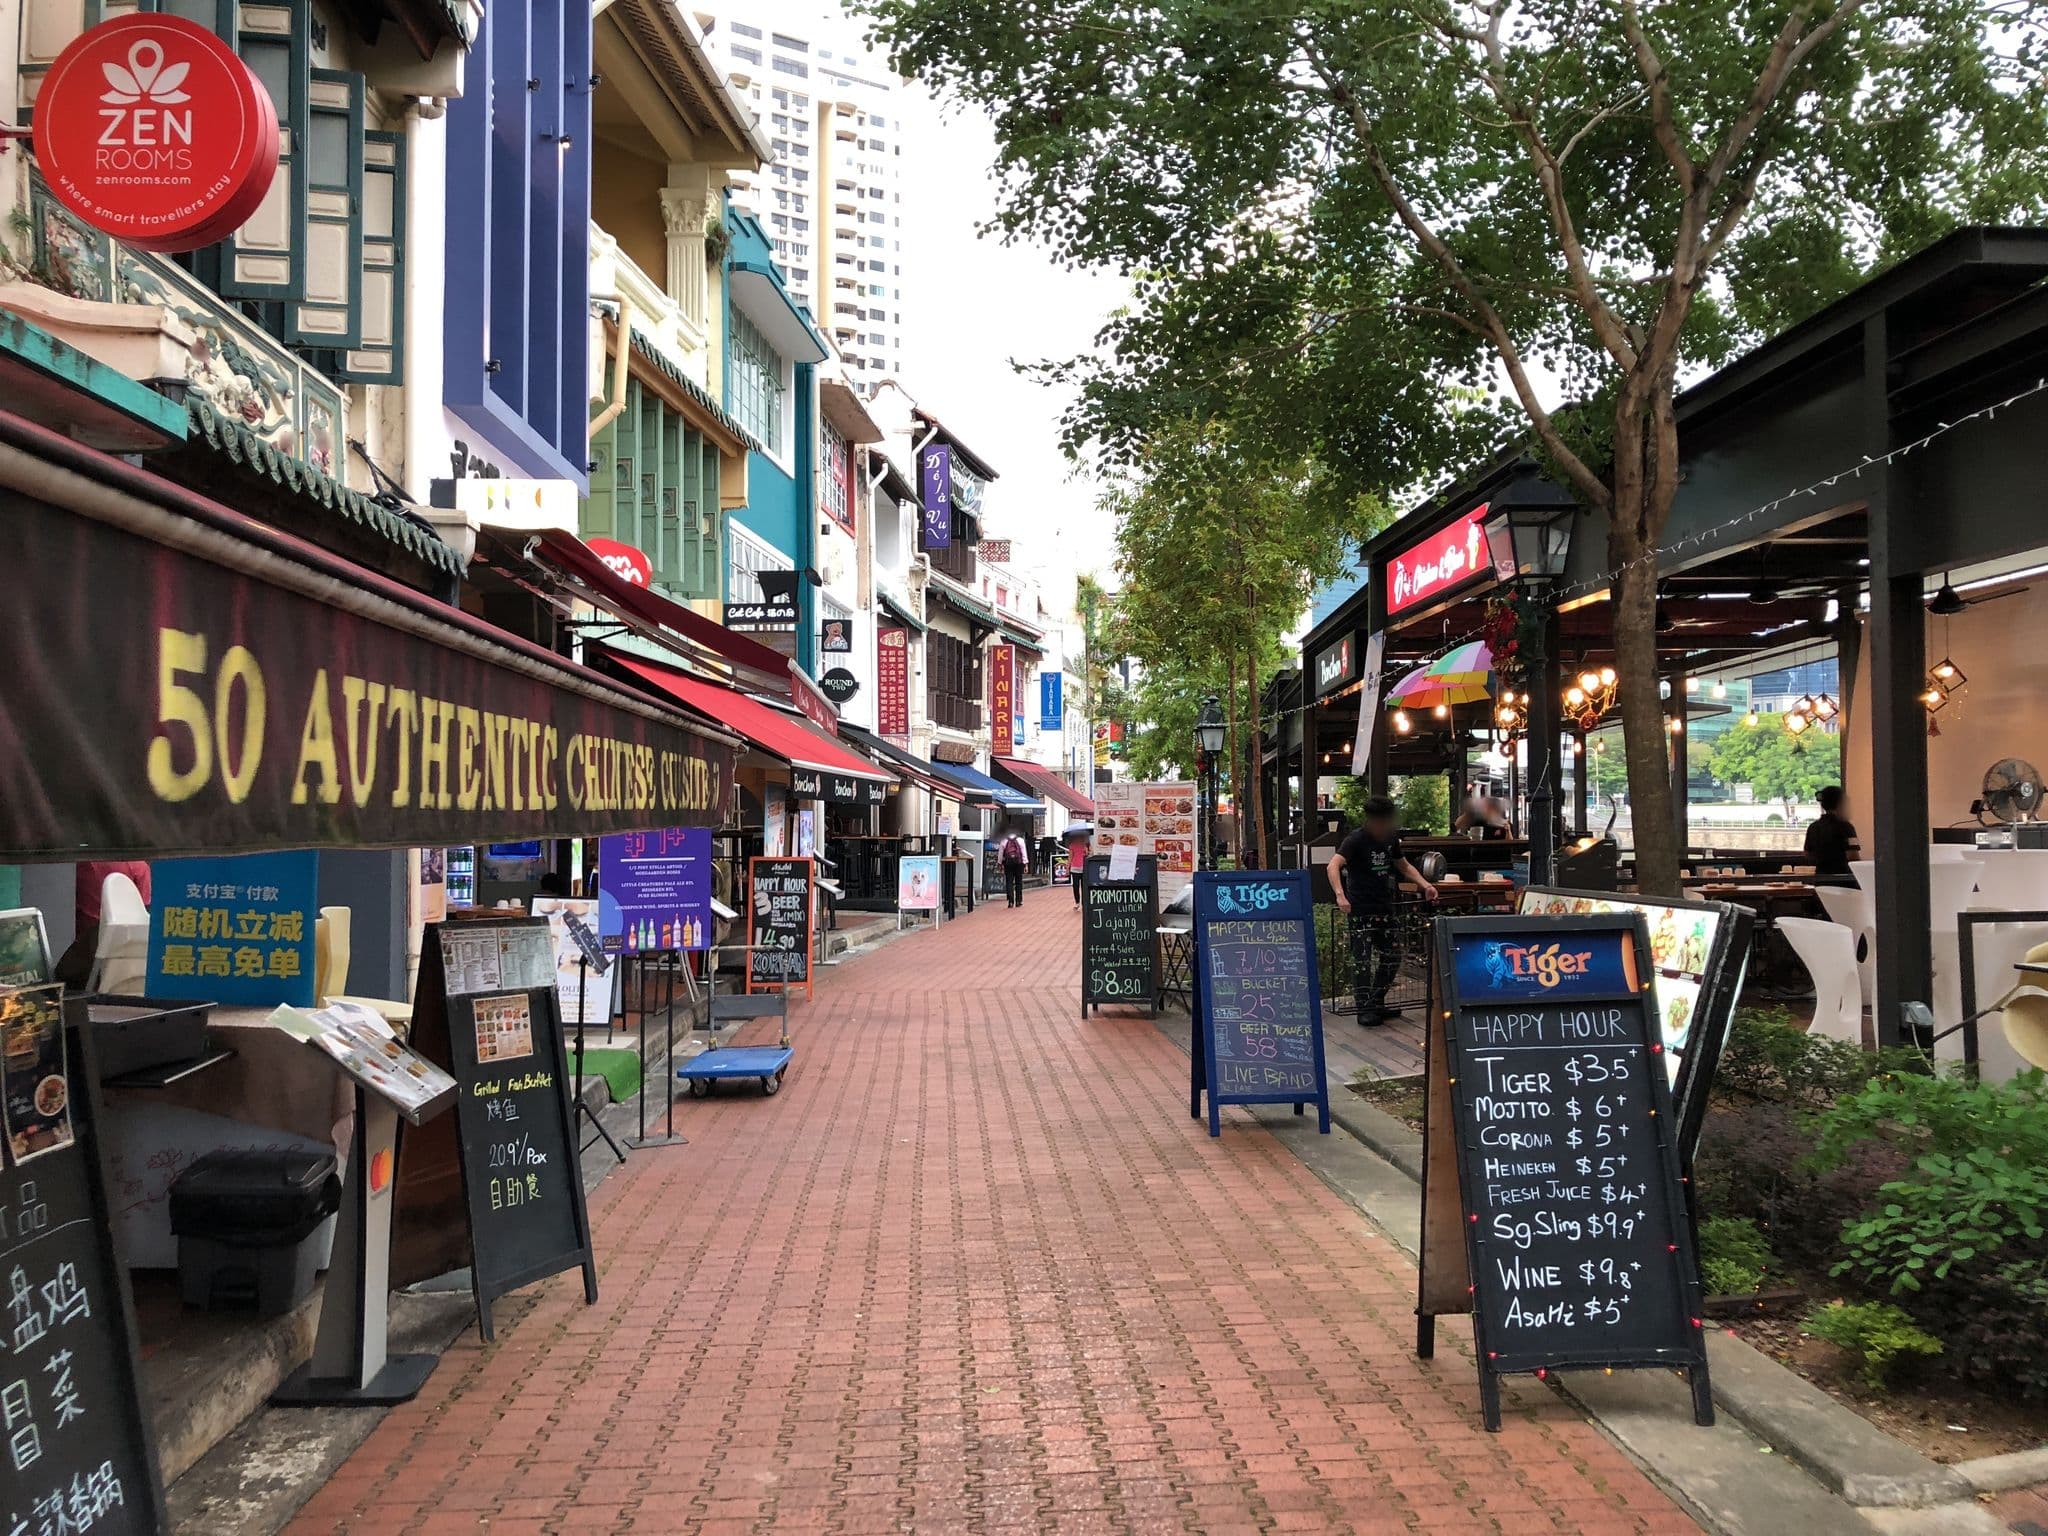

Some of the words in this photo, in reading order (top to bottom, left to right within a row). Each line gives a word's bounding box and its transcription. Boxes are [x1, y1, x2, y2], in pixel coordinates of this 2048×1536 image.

[97, 109, 192, 145] ZEN
[95, 149, 192, 171] ROOMS
[96, 176, 191, 185] zenrooms.com
[59, 174, 92, 208] where
[94, 204, 135, 225] smart
[140, 199, 205, 225] travellers
[205, 174, 231, 201] stay
[825, 678, 853, 687] ROUND
[996, 649, 1009, 738] KINARA
[147, 626, 267, 804] 50
[291, 668, 558, 812] AUTHENTIC
[754, 877, 781, 891] HAPPY
[783, 878, 808, 893] HOUR
[1089, 889, 1148, 905] PROMOTION
[1235, 883, 1289, 909] Tiger
[753, 892, 772, 916] 3
[772, 895, 801, 910] BEER
[162, 906, 304, 942] 随机立减
[1208, 921, 1257, 938] HAPPY
[1262, 920, 1297, 933] HOUR
[161, 945, 301, 979] 最高免单
[1505, 943, 1592, 988] Tiger
[1091, 969, 1141, 996] $8.80
[1240, 1023, 1269, 1035] BEER
[1273, 1024, 1312, 1037] TOWER
[1472, 1012, 1544, 1044] HAPPY
[1560, 1009, 1627, 1039] HOUR
[473, 1079, 501, 1097] Grilled
[1224, 1063, 1259, 1084] LIVE
[1263, 1067, 1314, 1089] BAND
[1474, 1056, 1552, 1094] TIGER
[1480, 1126, 1553, 1150] CORONA
[1484, 1158, 1556, 1179] HEINEKEN
[490, 1173, 542, 1210] 自助餐
[1487, 1184, 1541, 1206] FRESH
[1545, 1180, 1592, 1200] JUICE
[1496, 1255, 1562, 1291] WINE
